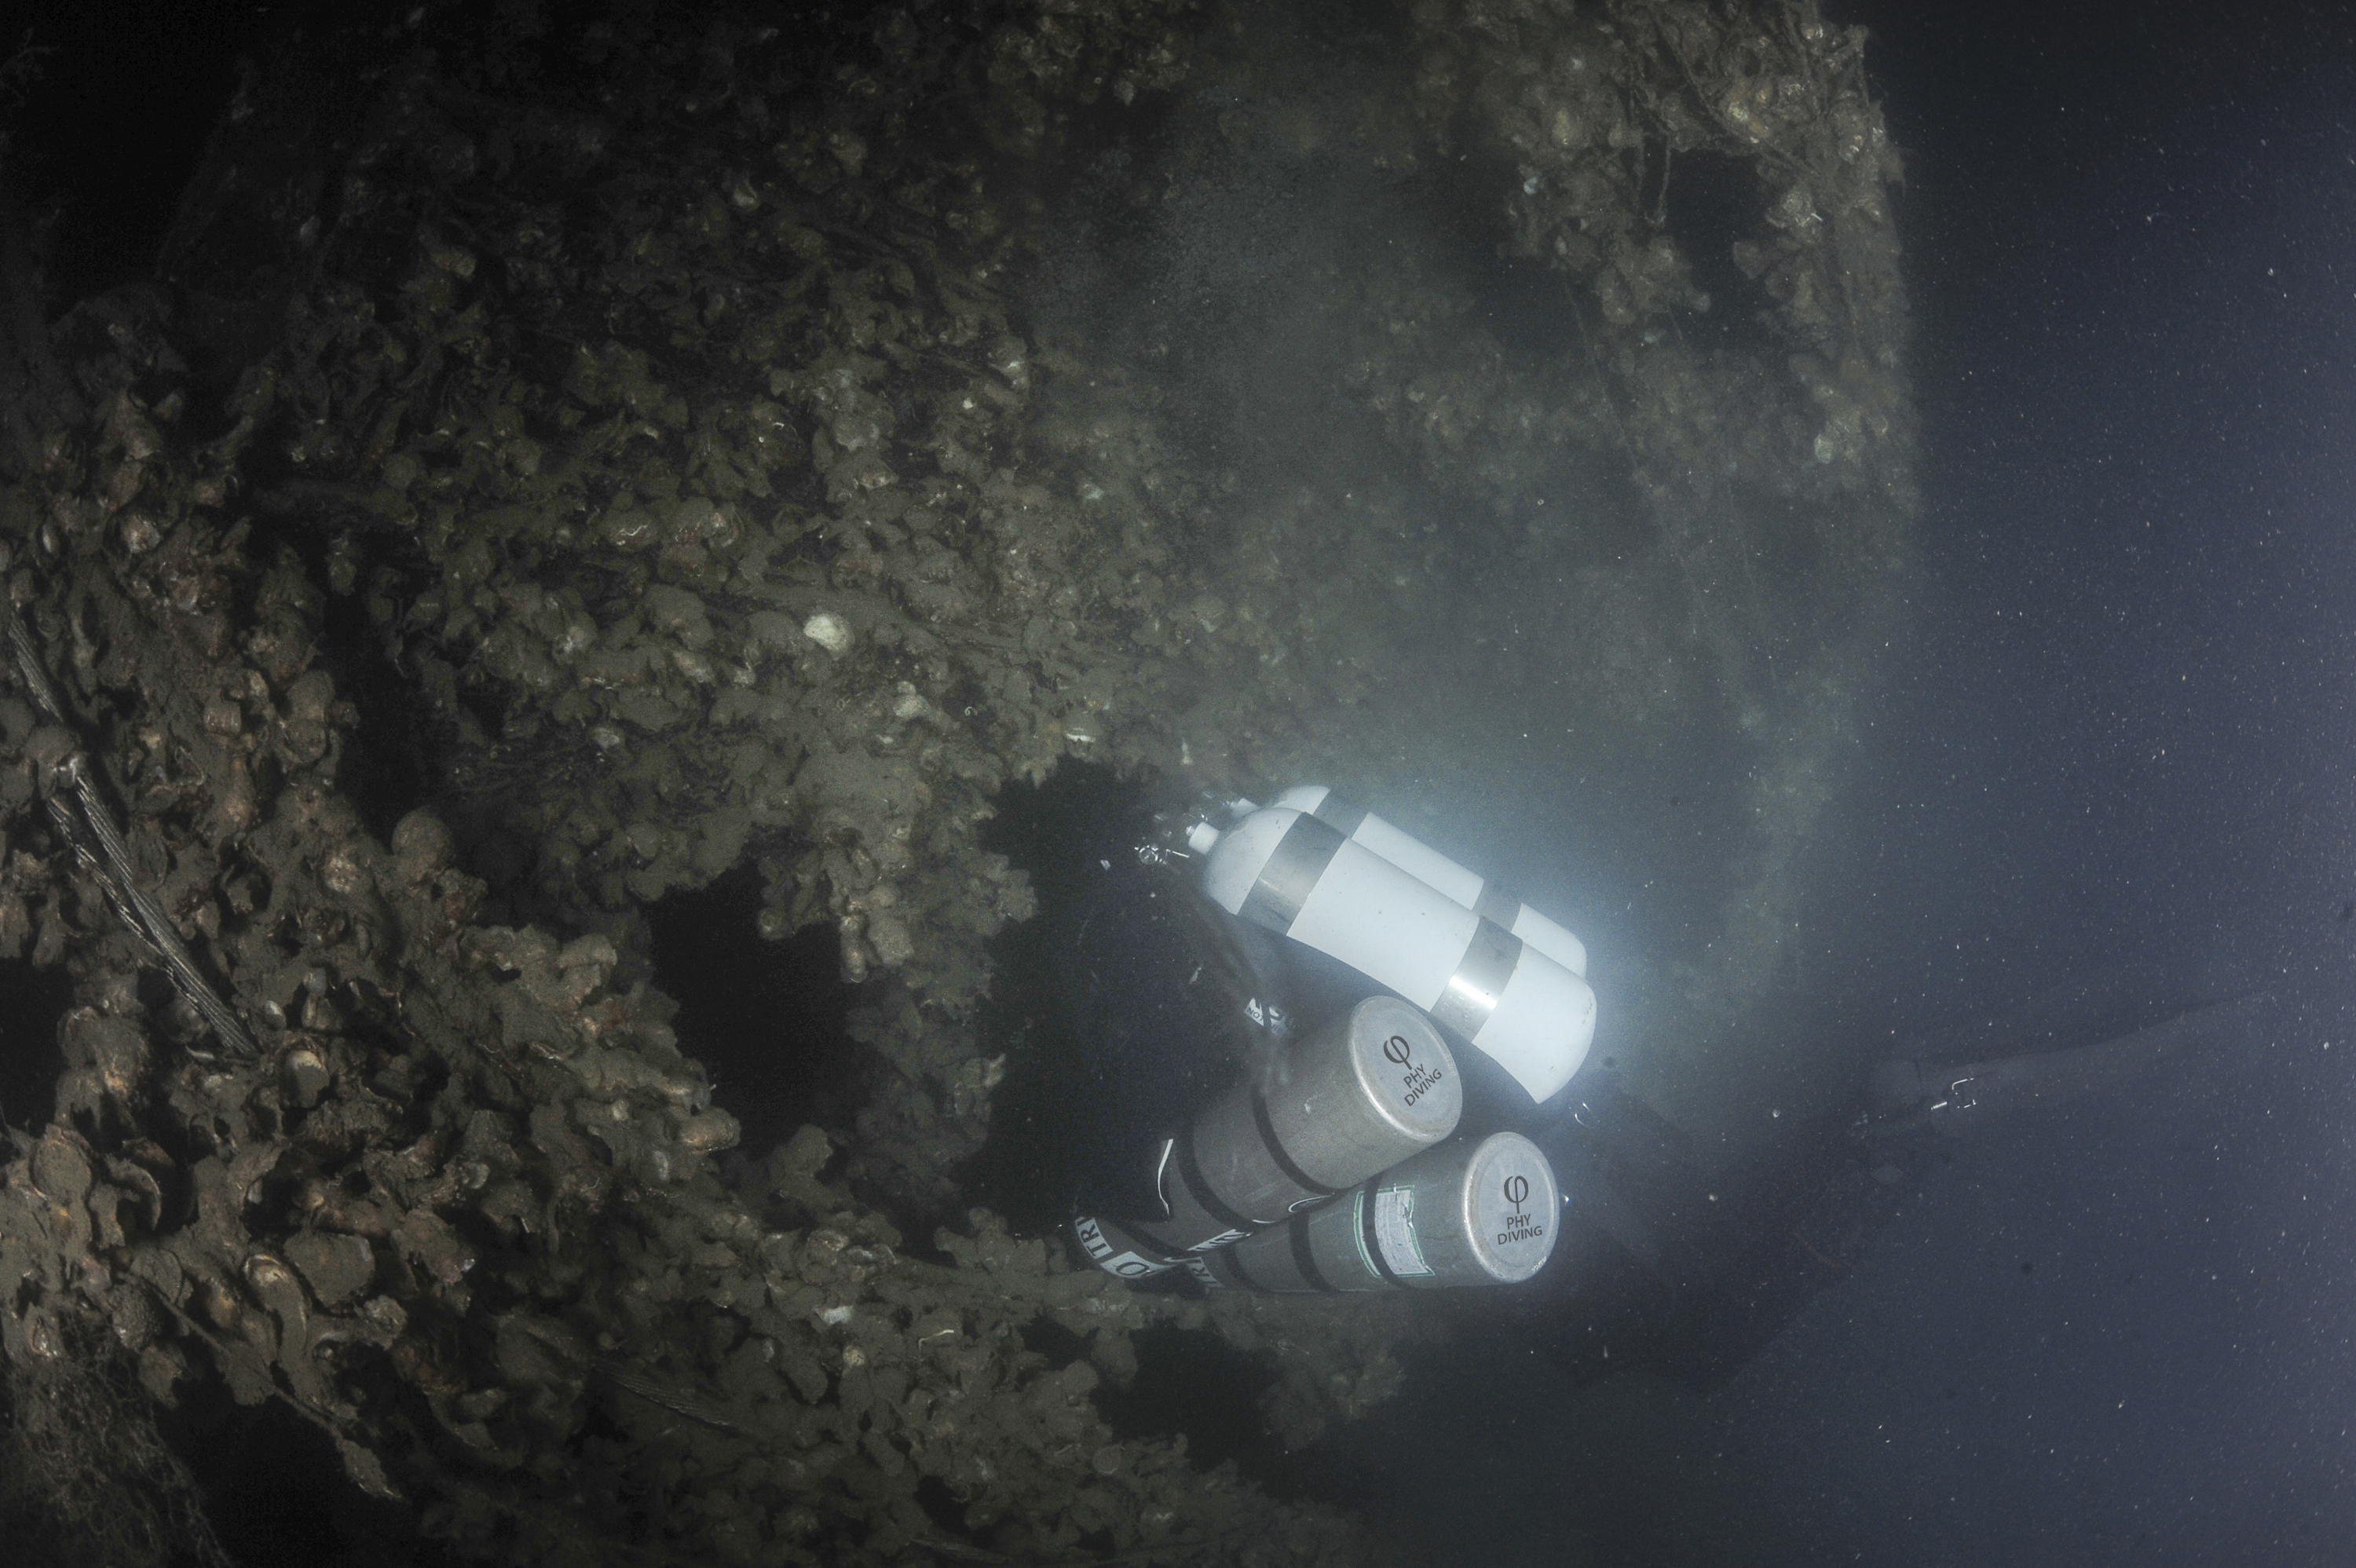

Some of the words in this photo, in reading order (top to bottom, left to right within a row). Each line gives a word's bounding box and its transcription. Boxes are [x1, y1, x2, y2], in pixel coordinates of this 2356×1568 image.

[1403, 1063, 1427, 1089] PHY
[1404, 1069, 1442, 1107] DIVING
[1506, 1214, 1531, 1230] PHY
[1498, 1226, 1542, 1245] DIVING
